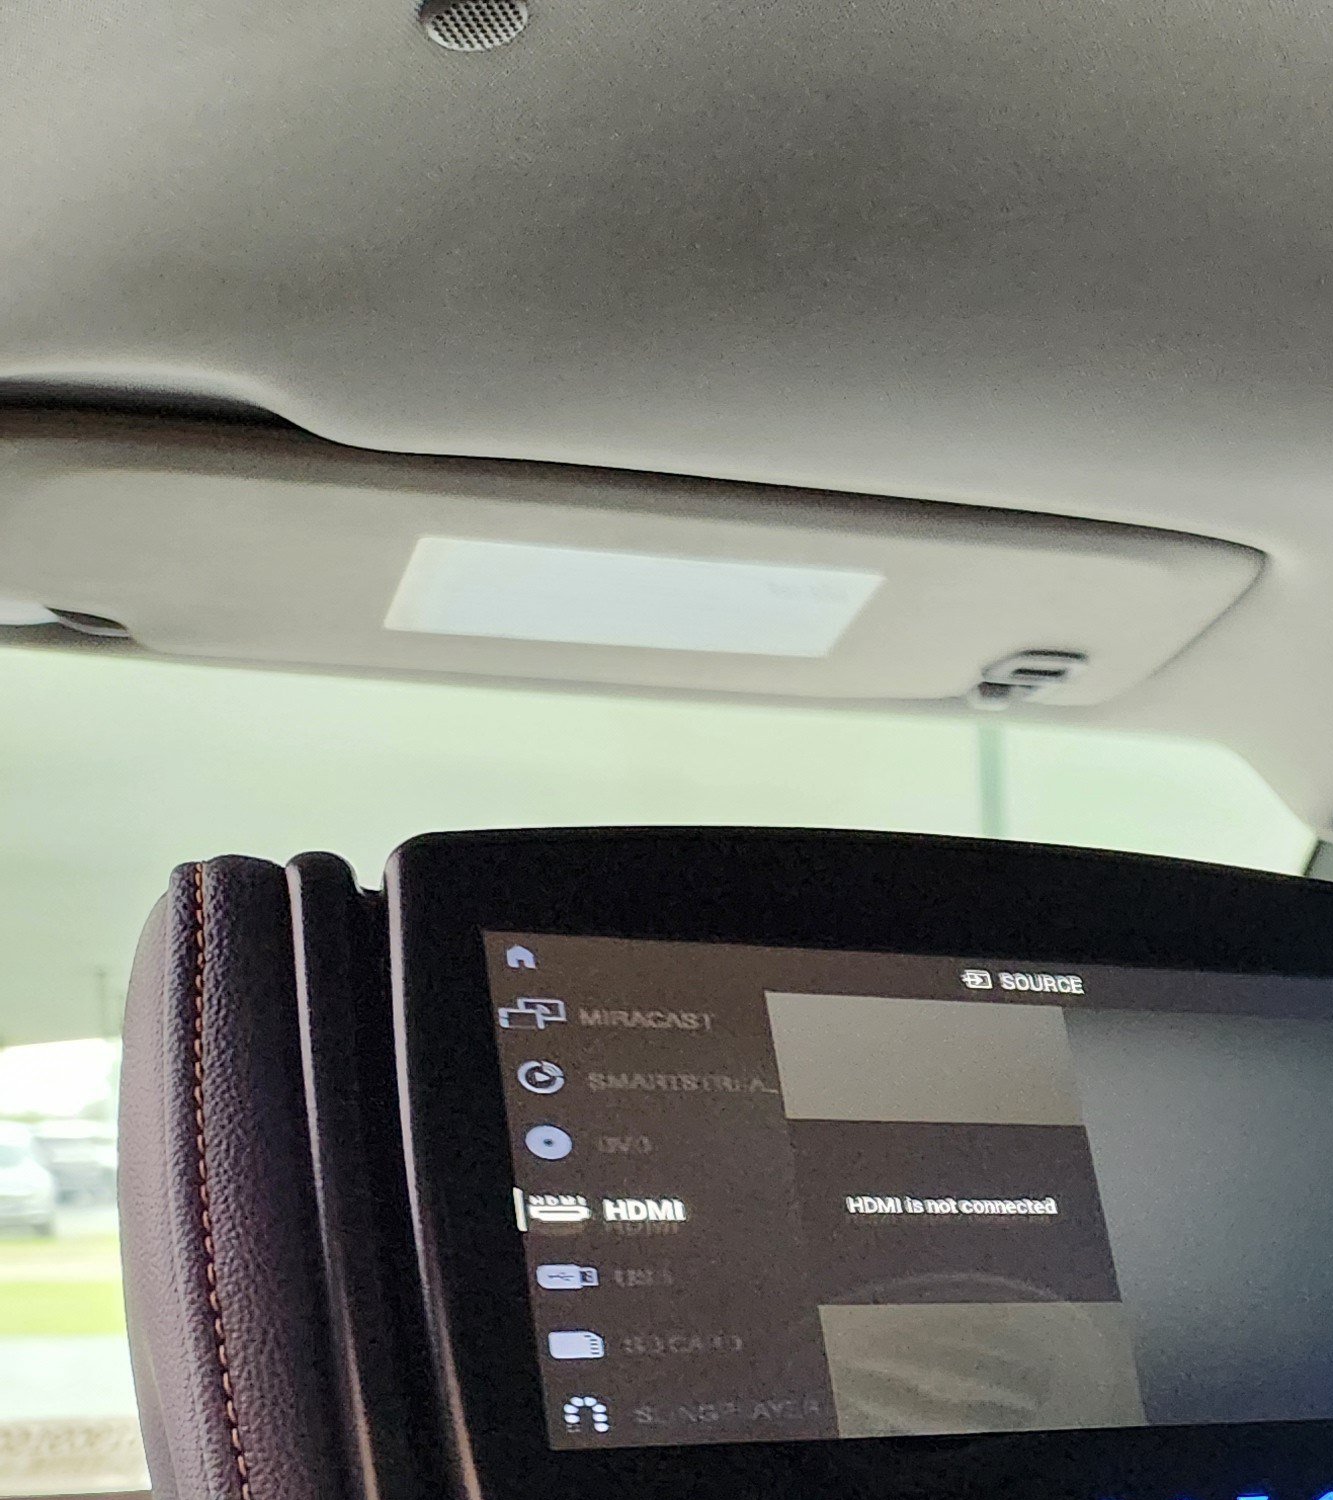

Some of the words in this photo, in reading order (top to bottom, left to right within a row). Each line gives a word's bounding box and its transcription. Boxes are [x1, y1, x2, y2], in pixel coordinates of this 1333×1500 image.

[998, 971, 1085, 995] SOURCE
[578, 1007, 716, 1032] MIRACAST
[602, 1198, 688, 1222] HDMI
[845, 1196, 903, 1214] HDMI
[905, 1197, 925, 1214] is
[926, 1197, 959, 1214] not
[958, 1197, 1058, 1215] connected
